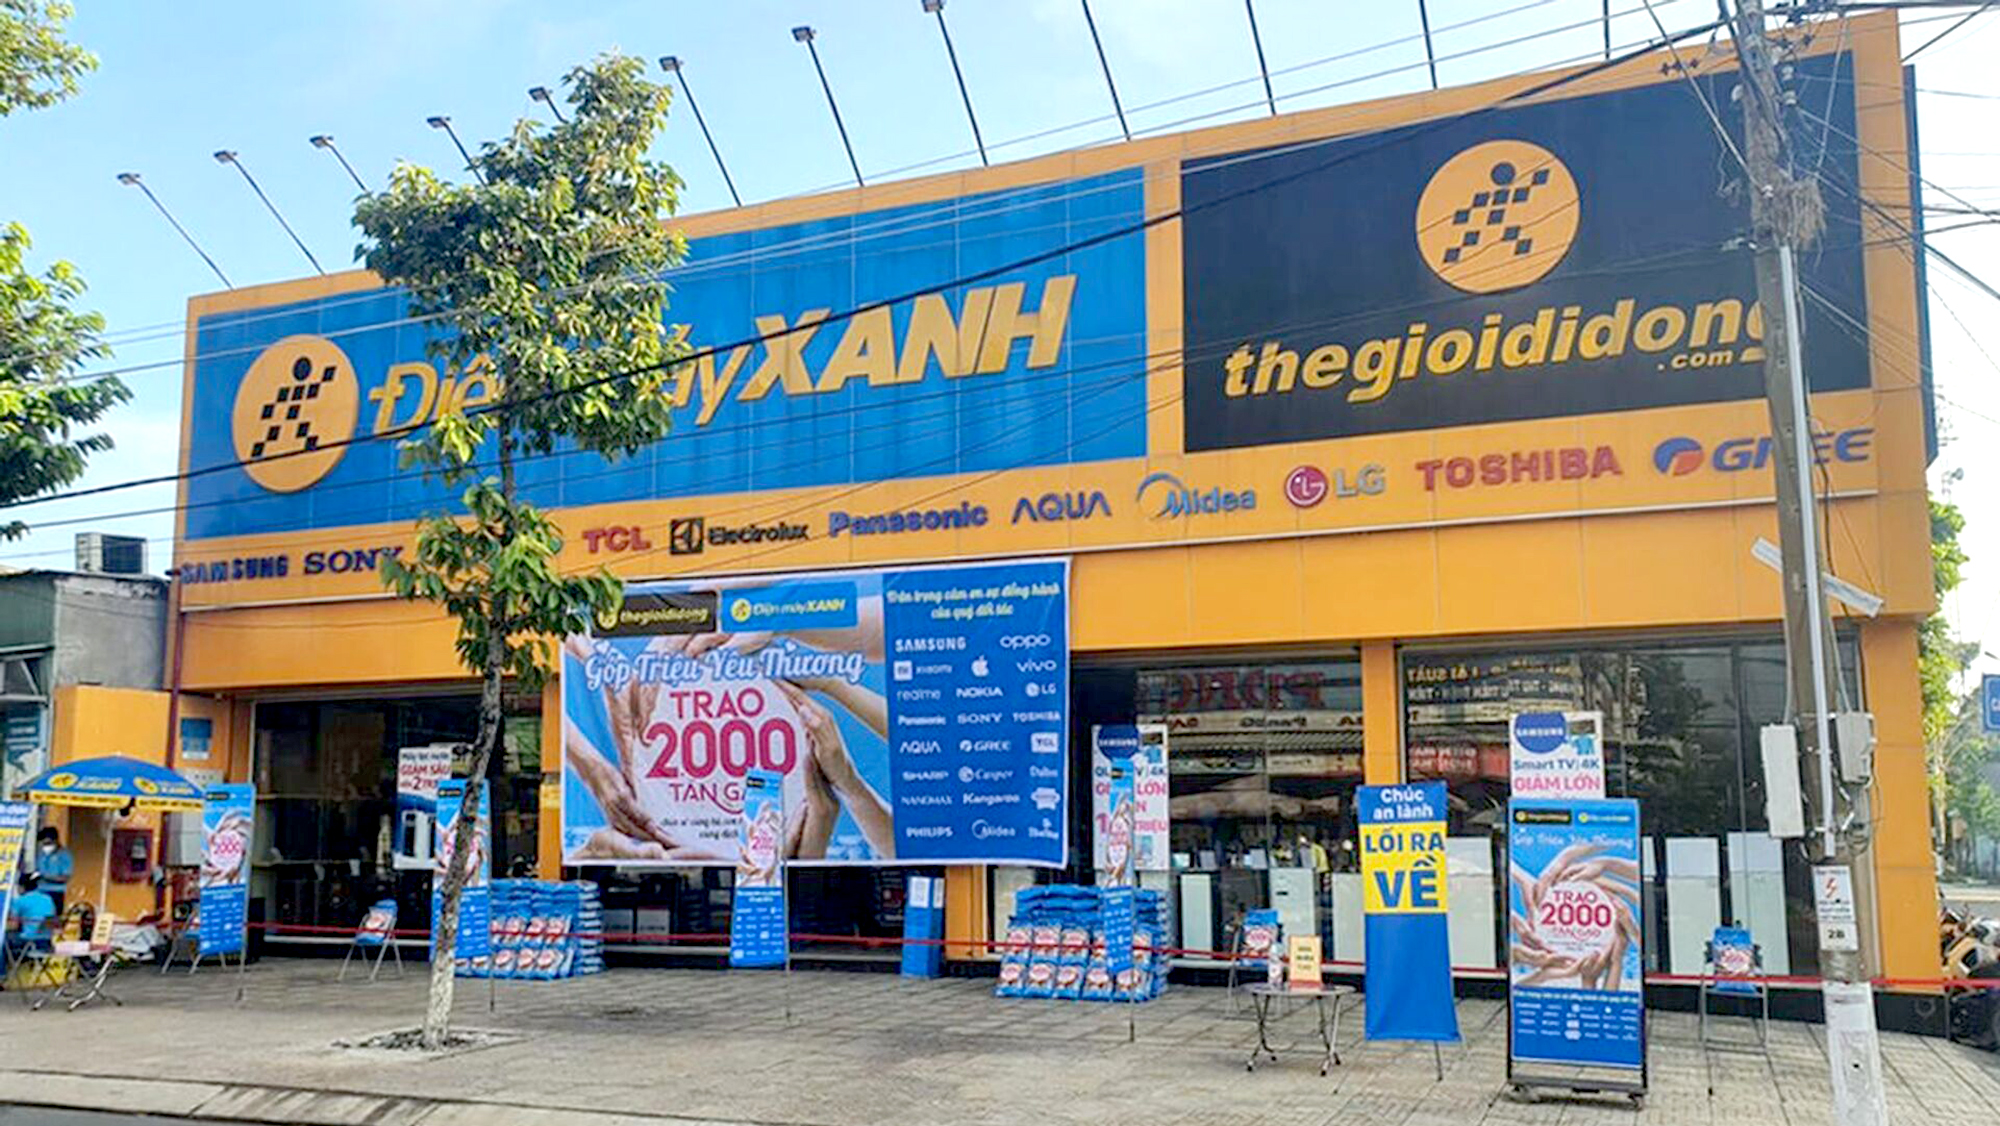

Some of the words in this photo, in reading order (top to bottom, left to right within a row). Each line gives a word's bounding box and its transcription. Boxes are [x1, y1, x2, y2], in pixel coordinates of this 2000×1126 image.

[1416, 446, 1622, 491] TOSHIBA
[1335, 465, 1386, 497] LG
[1012, 491, 1111, 525] AQUA
[1164, 479, 1256, 517] Midea
[828, 501, 988, 537] Panasonic
[582, 525, 651, 553] TCL
[708, 521, 808, 546] Electrolux
[181, 554, 288, 584] SAMSUNG
[303, 546, 404, 575] SONY
[895, 636, 966, 652] SAMSUNG
[1016, 659, 1057, 673] vivo
[670, 687, 765, 719] TRAO
[956, 687, 1003, 699] NOKIA
[898, 715, 946, 726] Panasonic
[957, 713, 1002, 725] SONY
[1012, 711, 1061, 722] TOSHIBA
[645, 717, 797, 779] 2000
[900, 741, 941, 753] AQUA
[1514, 760, 1554, 770] Smart
[902, 771, 950, 781] SHARP
[1380, 786, 1425, 803] Chúc
[1373, 808, 1395, 820] an
[1396, 801, 1434, 819] lành
[906, 826, 953, 838] PHILIPS
[1411, 832, 1445, 852] RA
[1374, 855, 1440, 908] VỀ
[1553, 890, 1598, 903] TRAO
[1541, 902, 1612, 927] 2000
